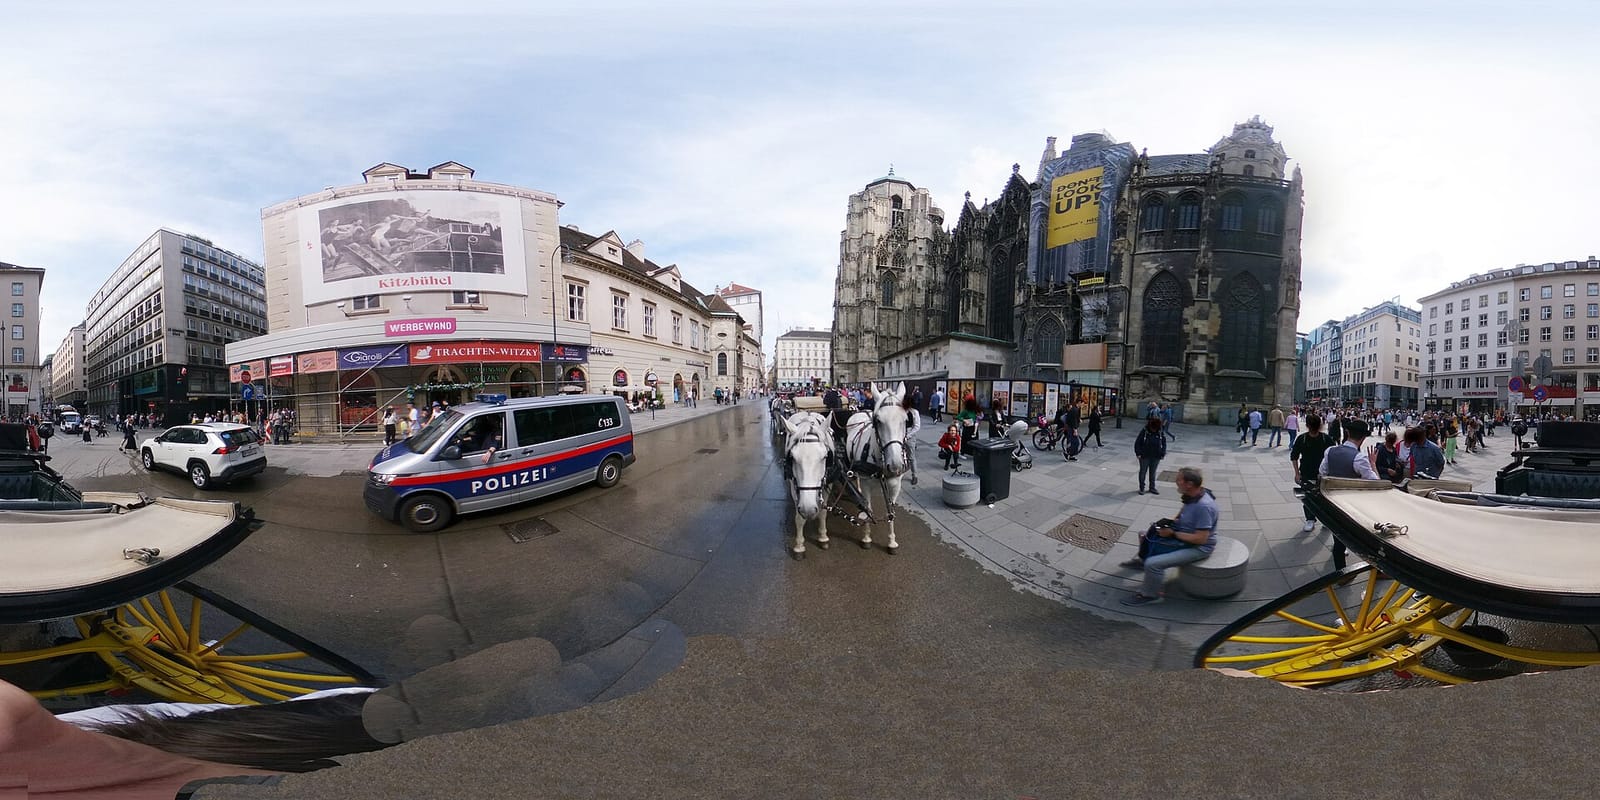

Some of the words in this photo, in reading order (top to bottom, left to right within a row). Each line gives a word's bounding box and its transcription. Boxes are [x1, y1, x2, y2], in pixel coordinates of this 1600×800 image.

[1056, 183, 1102, 200] LOOK
[1055, 191, 1101, 214] UP!
[379, 276, 452, 288] Kitzbühel
[389, 321, 452, 332] WERBEWAND
[434, 347, 538, 357] TRACHTEN-WITZKY
[603, 417, 613, 427] 133
[471, 467, 547, 494] POLIZEI
